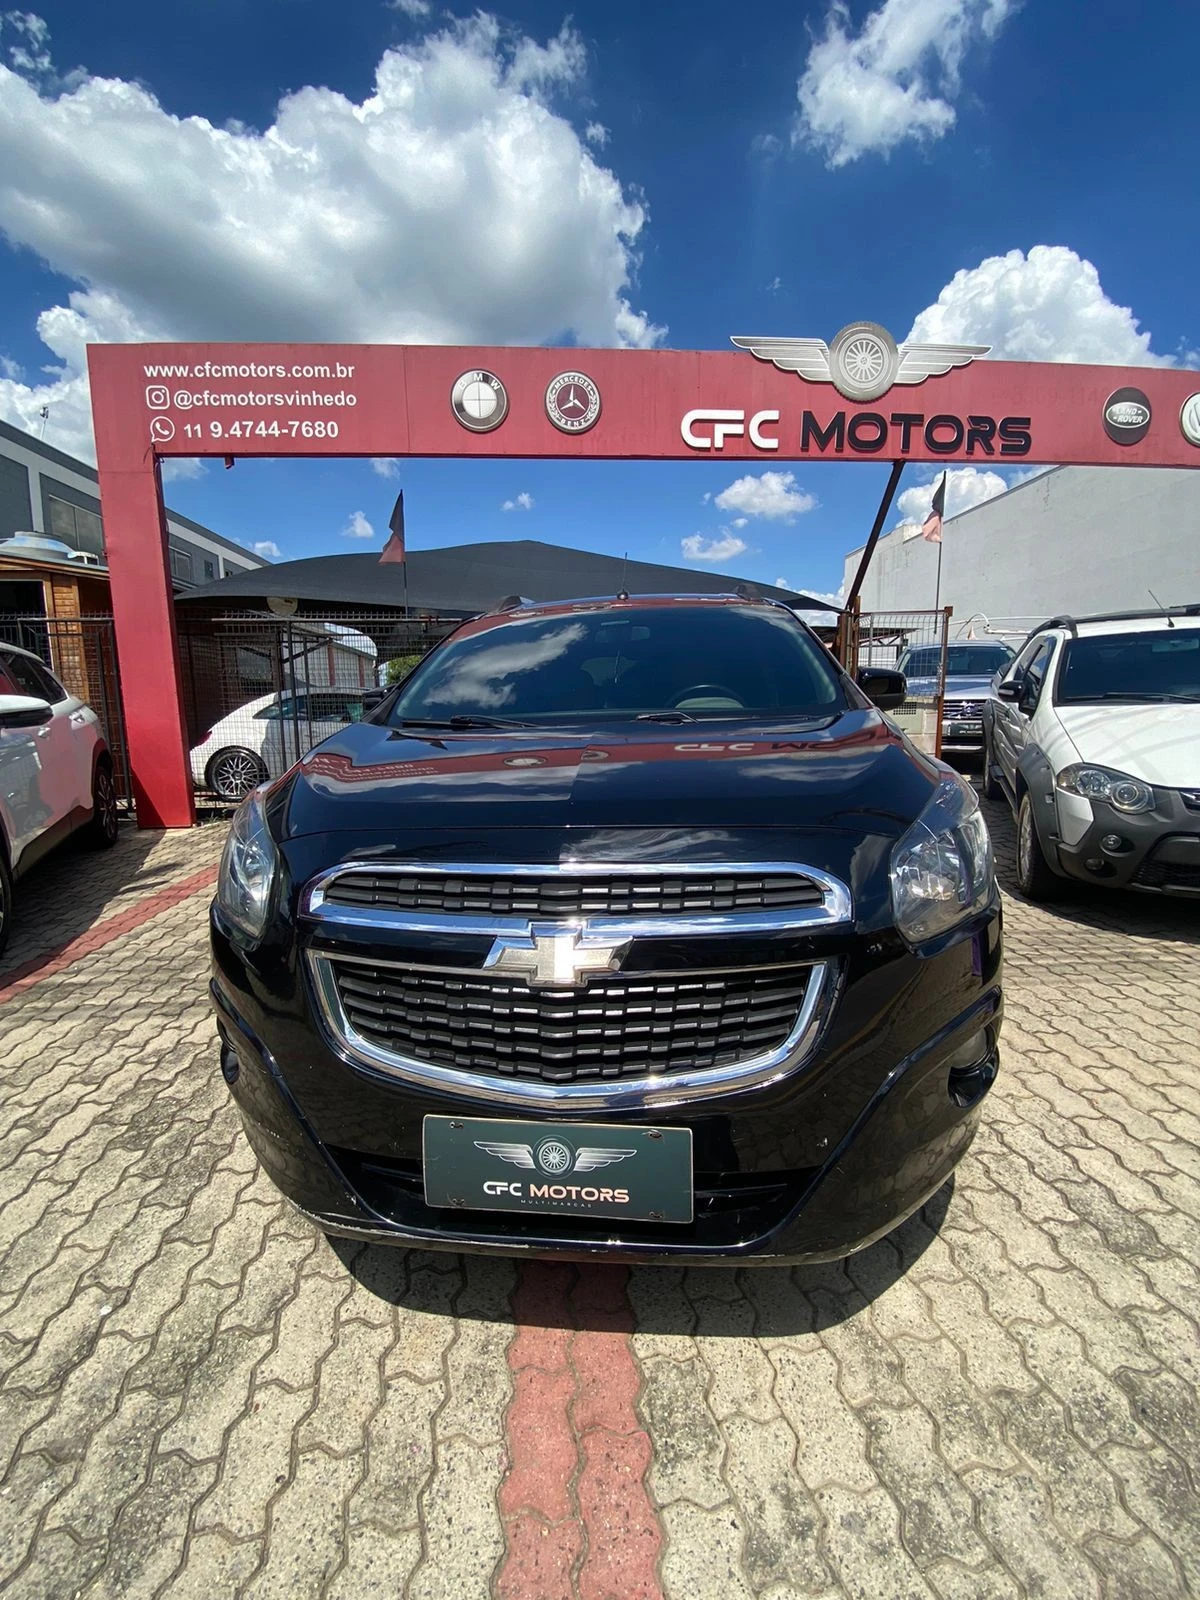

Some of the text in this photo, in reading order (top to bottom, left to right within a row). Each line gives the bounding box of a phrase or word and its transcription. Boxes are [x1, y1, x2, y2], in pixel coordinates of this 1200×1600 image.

[144, 361, 355, 378] www.cfcmotors.com.br
[459, 372, 501, 390] BMW
[174, 390, 357, 410] @cfcmotorsvinhedo
[1117, 415, 1143, 423] ROVER
[184, 420, 339, 438] 11 9.4744-7680
[681, 408, 1032, 455] CFC MOTORS
[483, 1181, 629, 1203] CFC MOTORS
